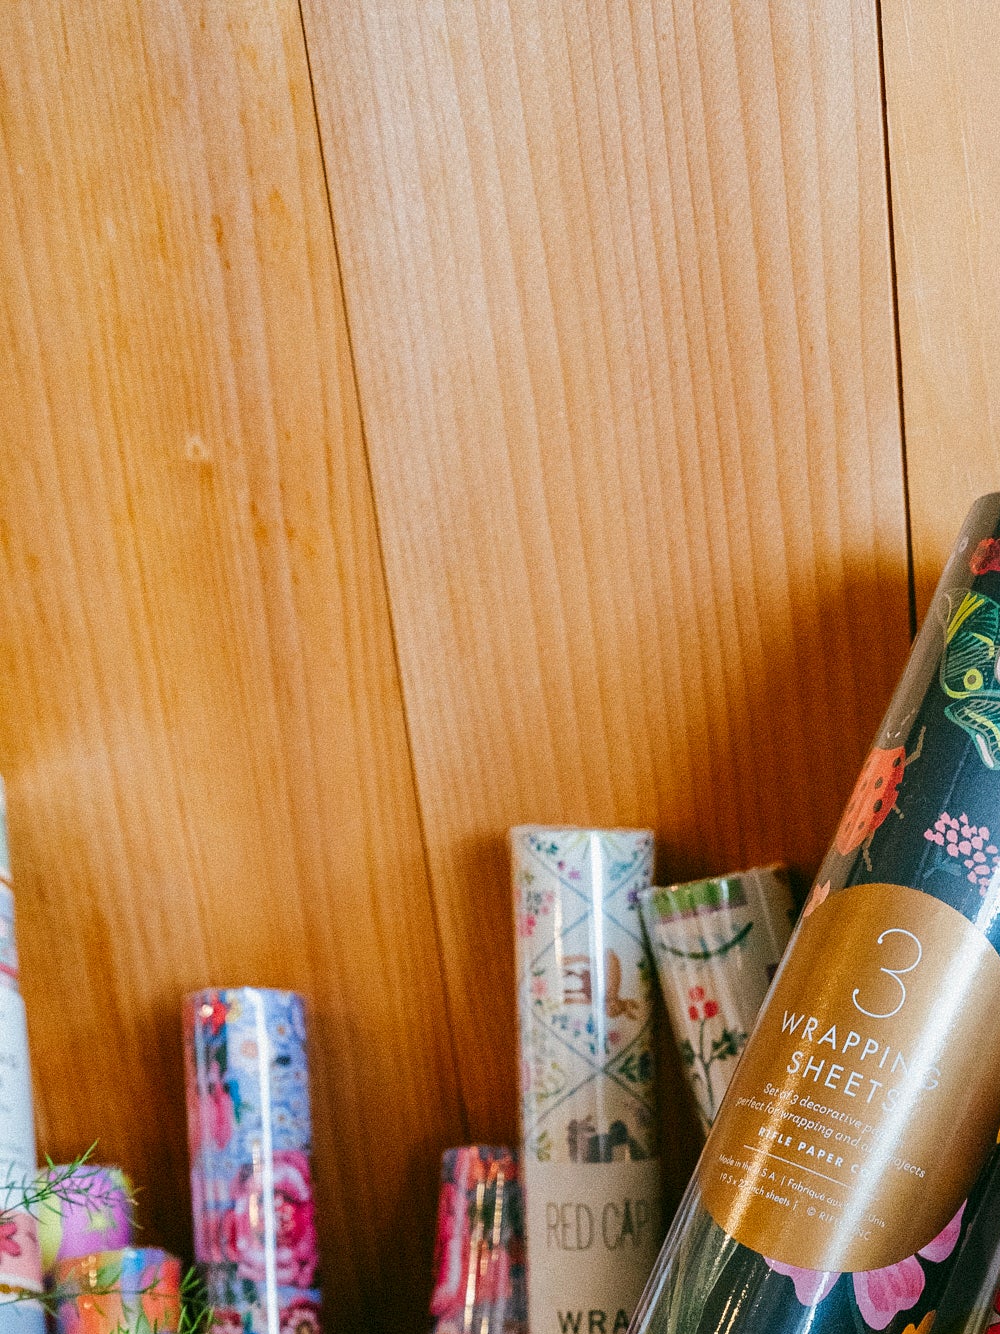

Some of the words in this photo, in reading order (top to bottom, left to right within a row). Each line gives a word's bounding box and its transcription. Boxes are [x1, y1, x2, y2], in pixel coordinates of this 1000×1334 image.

[852, 927, 922, 1019] 3
[781, 1010, 942, 1091] WRAPPING
[763, 1083, 780, 1099] Set
[790, 1094, 799, 1105] 3
[799, 1095, 862, 1129] decorative
[786, 1051, 902, 1113] SHEETS
[736, 1096, 765, 1111] perfect
[779, 1109, 834, 1138] wrapping
[834, 1131, 863, 1147] and
[718, 1153, 736, 1167] Made
[758, 1126, 793, 1147] RIFLE
[797, 1141, 845, 1168] PAPER
[765, 1188, 791, 1208] sheets
[546, 1201, 596, 1251] RED
